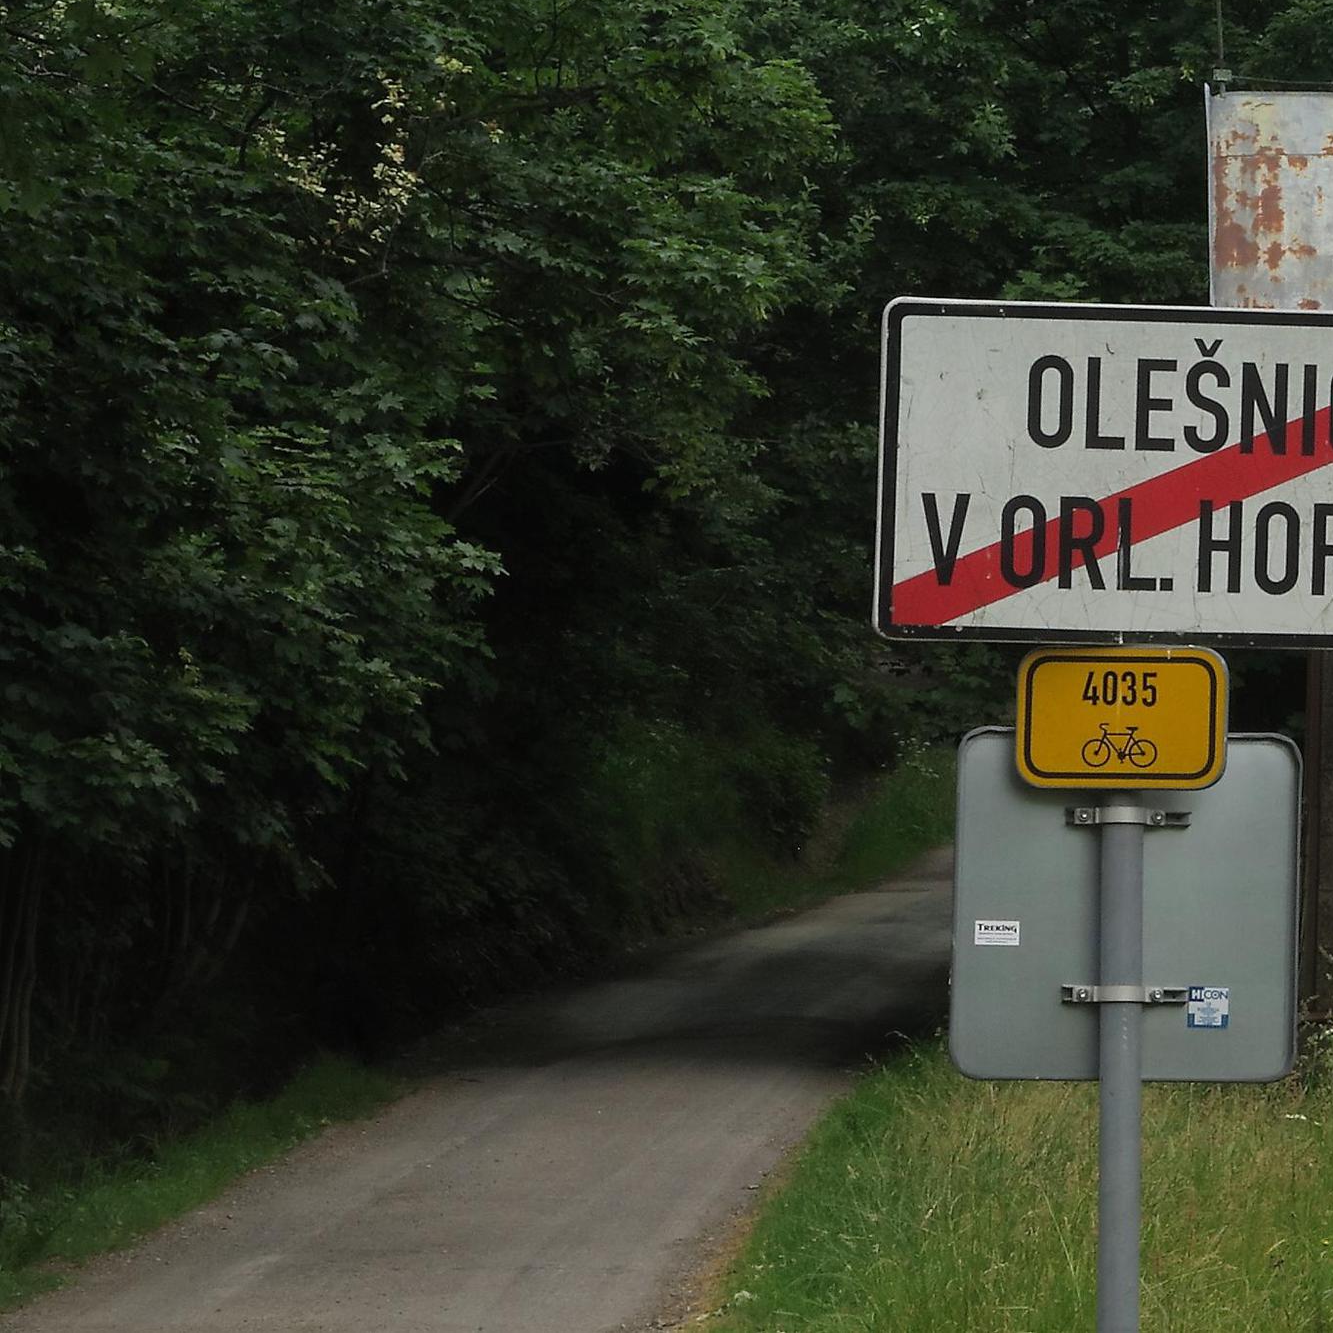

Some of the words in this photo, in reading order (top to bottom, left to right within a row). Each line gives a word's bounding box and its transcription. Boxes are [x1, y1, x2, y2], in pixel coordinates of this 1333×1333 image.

[921, 492, 971, 587] V
[1000, 494, 1174, 592] ORL.
[1082, 670, 1158, 707] 4035
